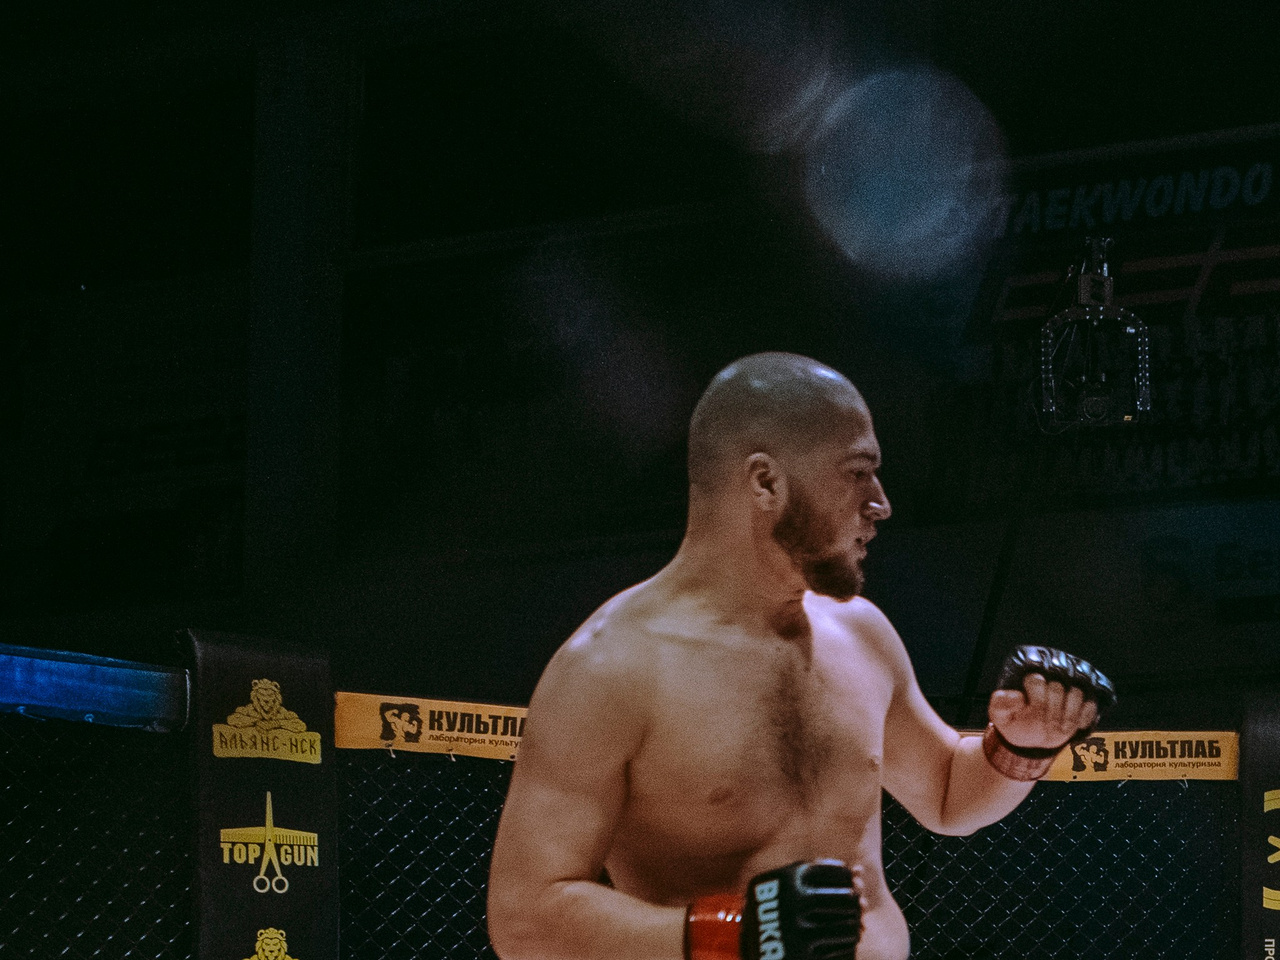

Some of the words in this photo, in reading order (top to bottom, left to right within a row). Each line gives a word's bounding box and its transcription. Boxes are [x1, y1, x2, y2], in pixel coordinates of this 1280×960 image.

[988, 162, 1272, 238] TAEKWONDO
[429, 709, 525, 738] КУЛЬТЛ
[428, 733, 486, 746] лаборатория
[1114, 739, 1222, 759] КУЛЬТЛАБ
[1114, 761, 1167, 770] лаборатория
[1168, 760, 1222, 770] культуризма
[220, 843, 260, 864] TOP
[280, 845, 319, 867] GUN
